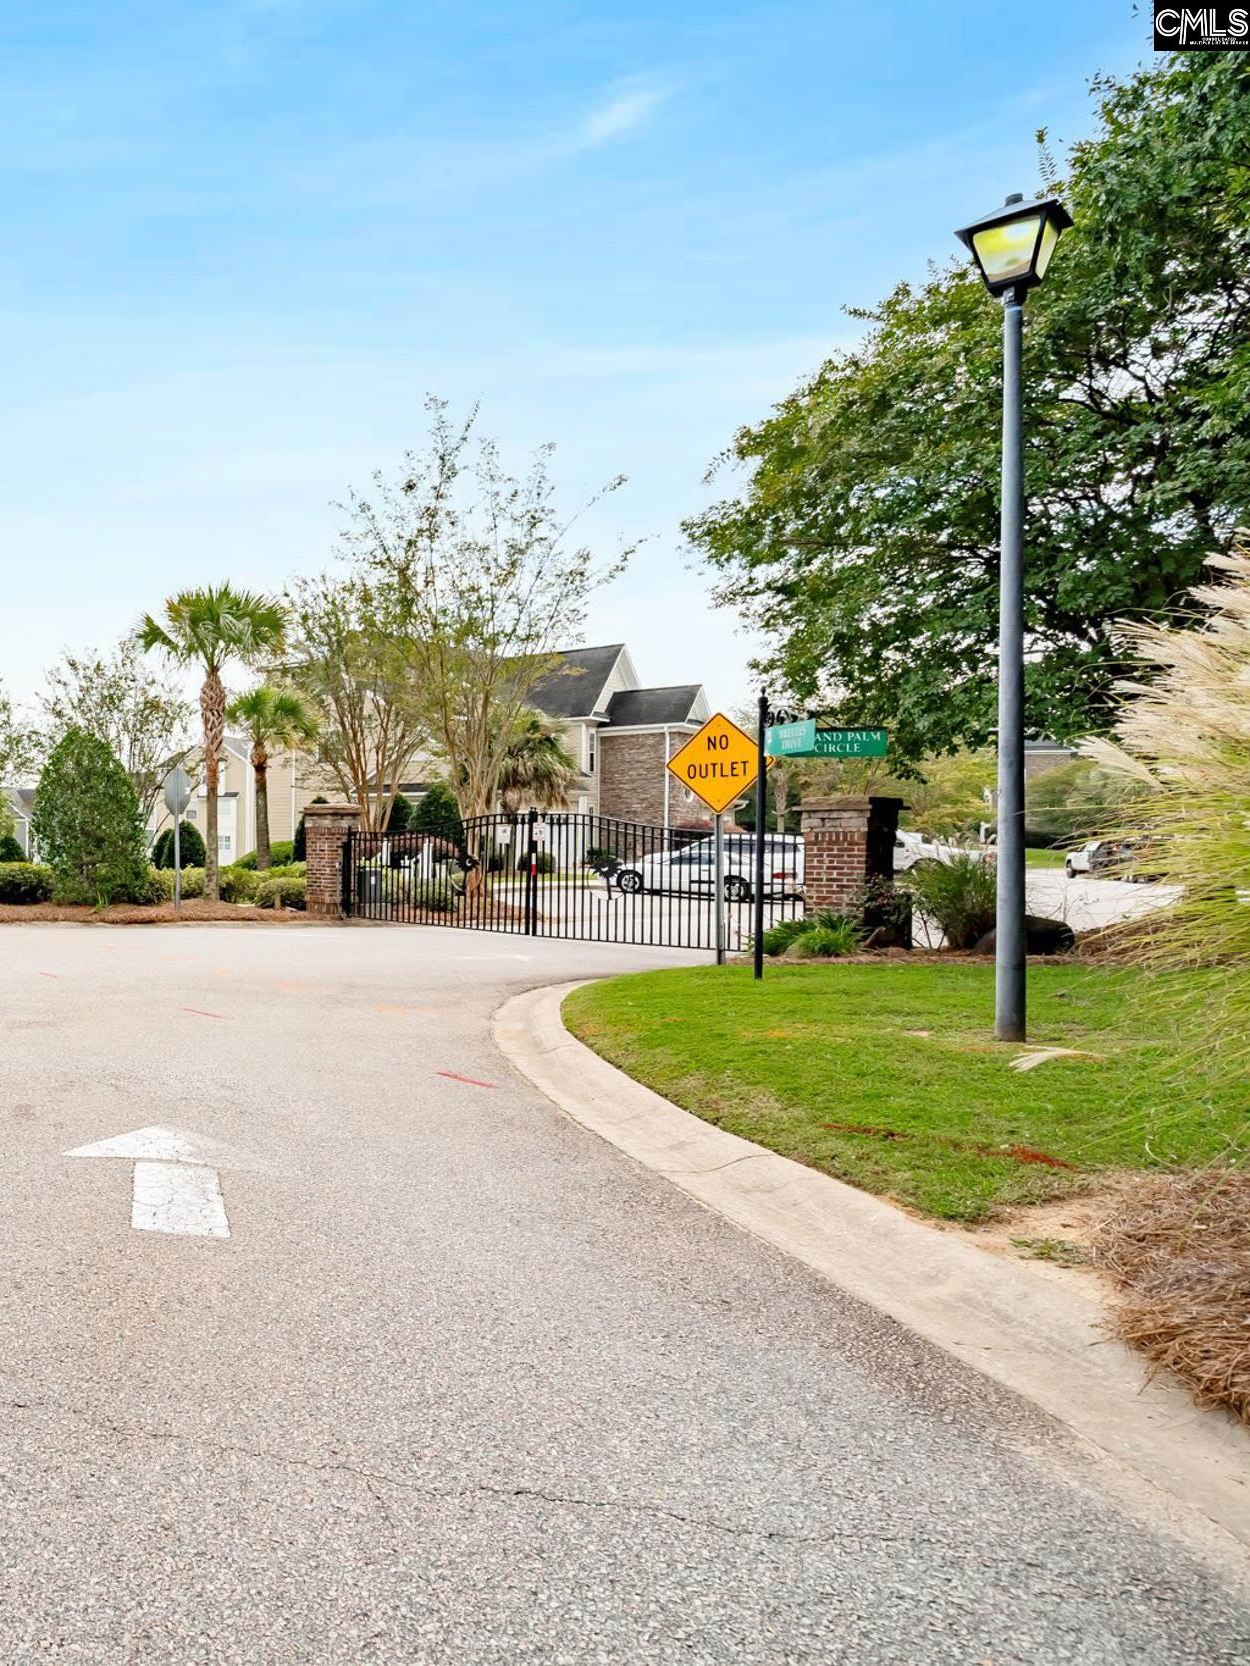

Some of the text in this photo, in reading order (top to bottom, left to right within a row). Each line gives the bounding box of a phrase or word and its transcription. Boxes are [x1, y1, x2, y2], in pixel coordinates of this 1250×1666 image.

[707, 734, 729, 751] NO
[814, 731, 881, 742] AND PALM
[814, 743, 861, 753] CIRCLE
[687, 760, 749, 779] OUTLET
